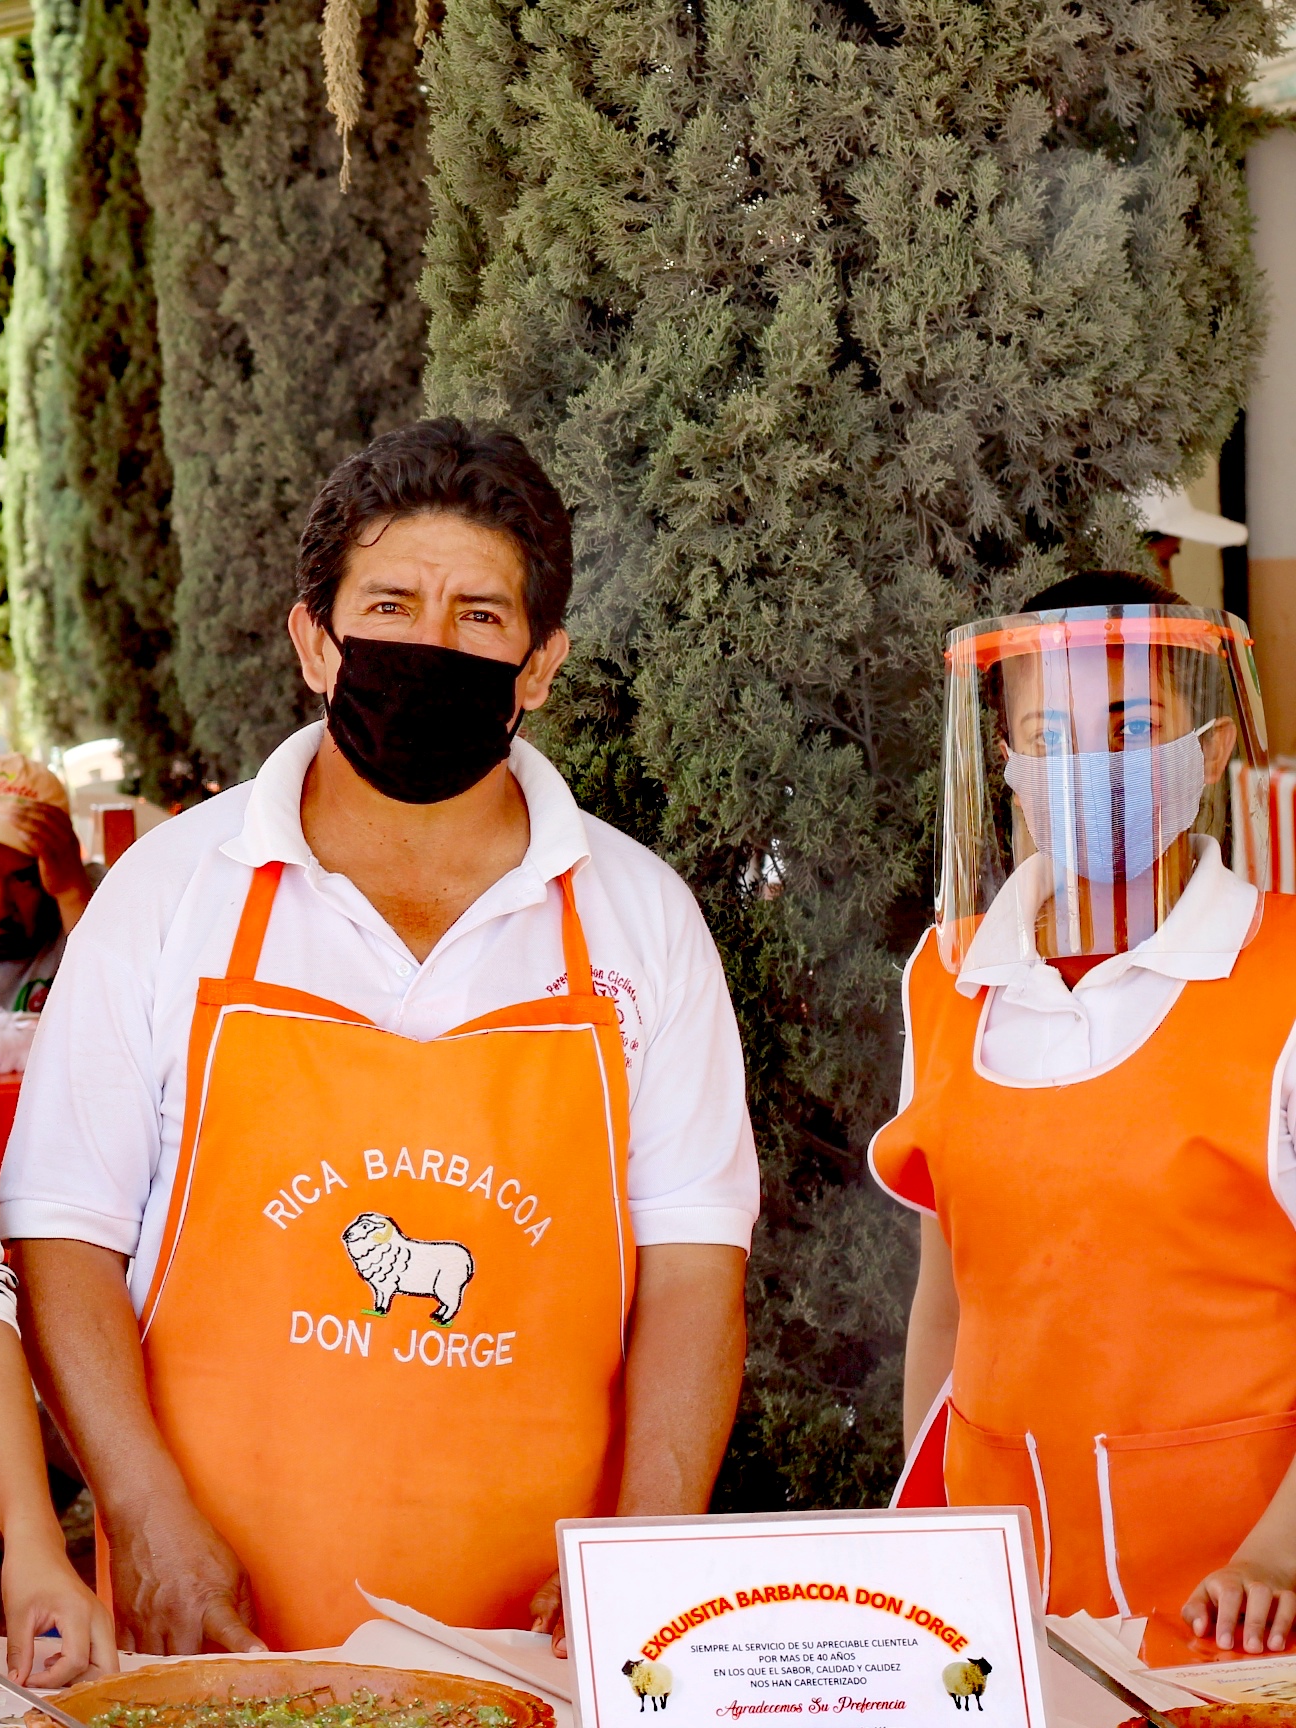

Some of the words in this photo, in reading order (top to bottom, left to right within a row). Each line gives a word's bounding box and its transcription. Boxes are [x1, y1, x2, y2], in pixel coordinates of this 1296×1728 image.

[262, 1159, 349, 1230] RICA
[363, 1146, 553, 1248] BARBACOA
[289, 1310, 372, 1357] DON
[393, 1328, 517, 1368] JORGE
[641, 1597, 734, 1662] EXQUISITA
[736, 1583, 850, 1608] BARBACOA
[855, 1588, 904, 1615] DON
[905, 1605, 969, 1653] JORGE
[690, 1643, 730, 1653] SIEMPRE
[732, 1643, 744, 1652] AL
[745, 1642, 786, 1652] SERVICIO
[788, 1641, 800, 1650] DE
[802, 1641, 814, 1650] SU
[816, 1639, 869, 1649] APRECIABLE
[871, 1638, 919, 1648] CLIENTELA
[758, 1655, 778, 1663] POR
[780, 1654, 801, 1662] MAS
[803, 1653, 815, 1662] DE
[816, 1653, 828, 1662] 40
[830, 1651, 856, 1661] AÑOS
[713, 1668, 726, 1677] EN
[728, 1668, 745, 1676] LOS
[747, 1667, 767, 1677] QUE
[769, 1667, 779, 1675] EL
[781, 1666, 814, 1675] SABOR,
[816, 1664, 855, 1673] CALIDAD
[856, 1664, 862, 1673] Y
[864, 1663, 901, 1672] CALIDEZ
[750, 1679, 770, 1688] NOS
[772, 1678, 792, 1687] HAN
[794, 1677, 867, 1687] CARECTERIZADO
[716, 1699, 803, 1720] Agradecemos
[808, 1697, 829, 1714] Su
[833, 1696, 907, 1714] Preferencia
